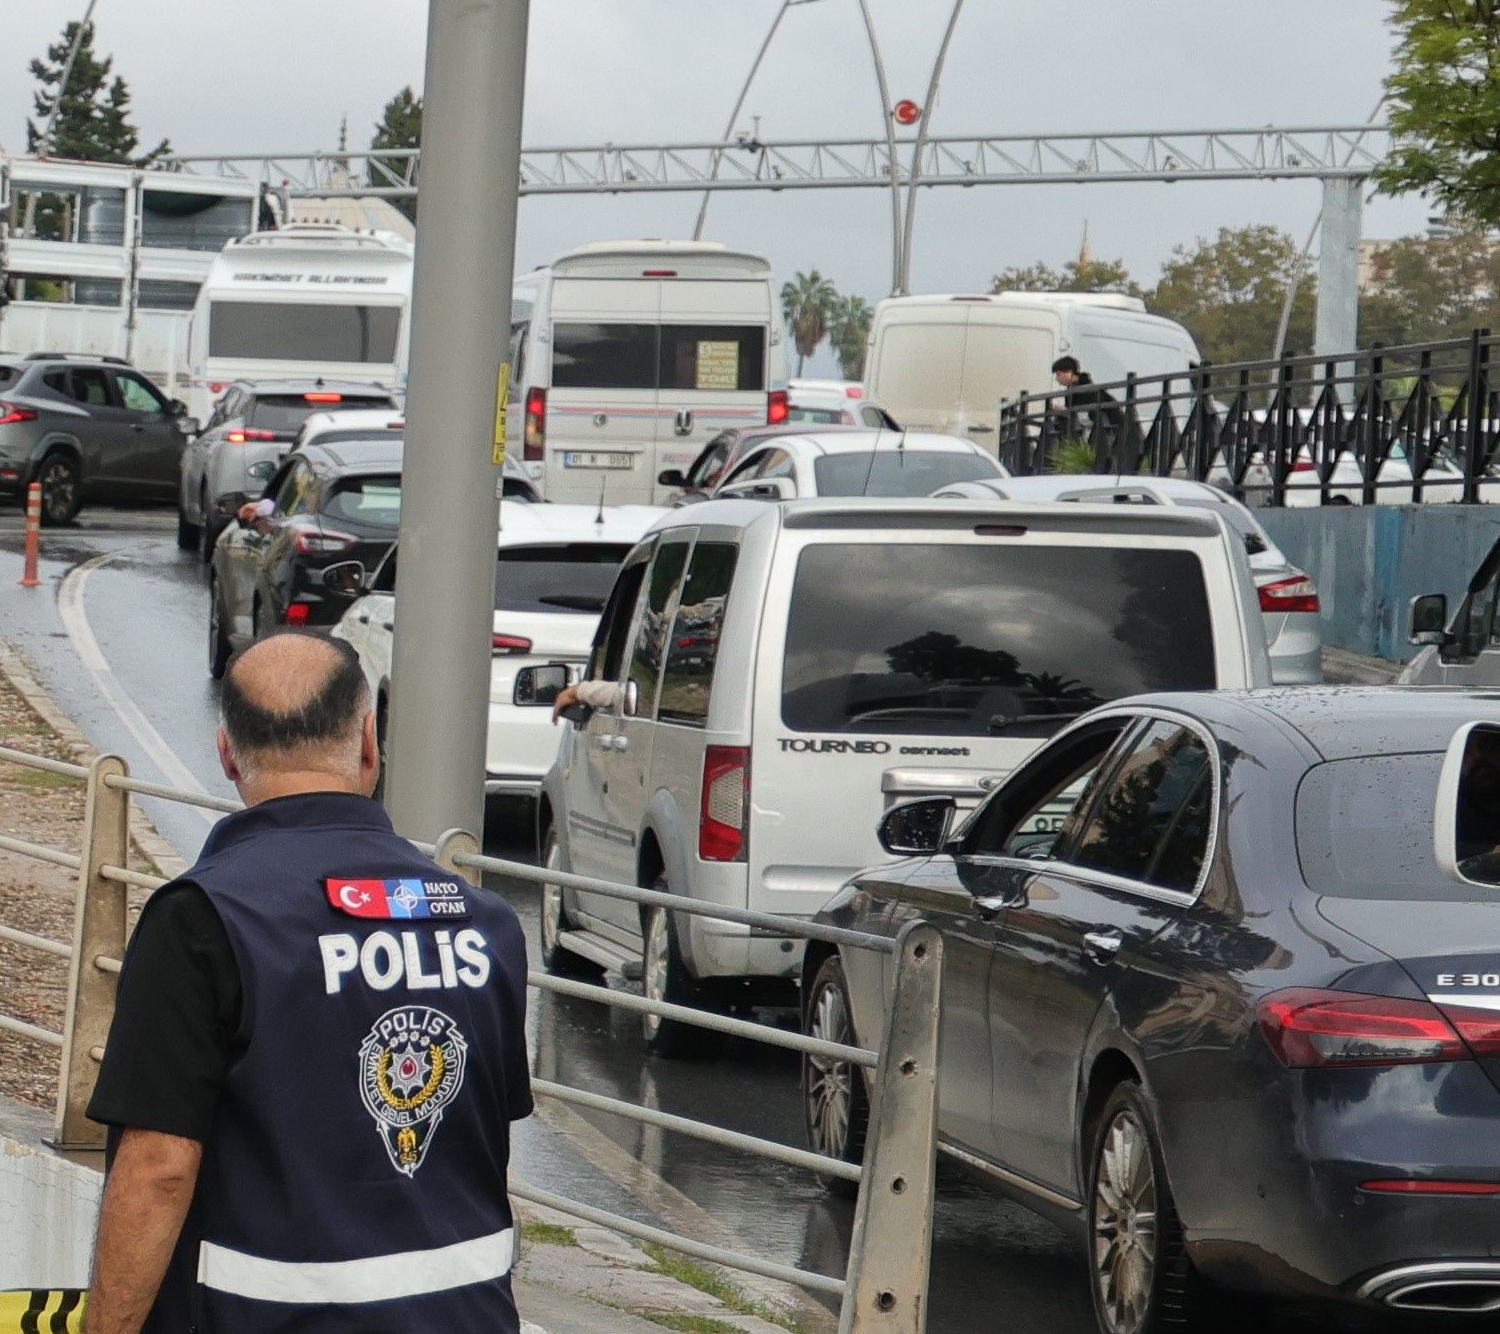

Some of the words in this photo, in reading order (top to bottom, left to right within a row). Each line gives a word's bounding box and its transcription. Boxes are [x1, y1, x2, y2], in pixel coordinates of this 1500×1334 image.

[778, 738, 891, 754] TOURNEO
[900, 746, 970, 756] connect
[425, 882, 458, 894] NATO
[430, 901, 466, 913] OTAN
[318, 929, 490, 995] POLİS
[1437, 974, 1455, 986] E
[380, 1010, 445, 1040] POLİS
[380, 1103, 414, 1124] GENEL
